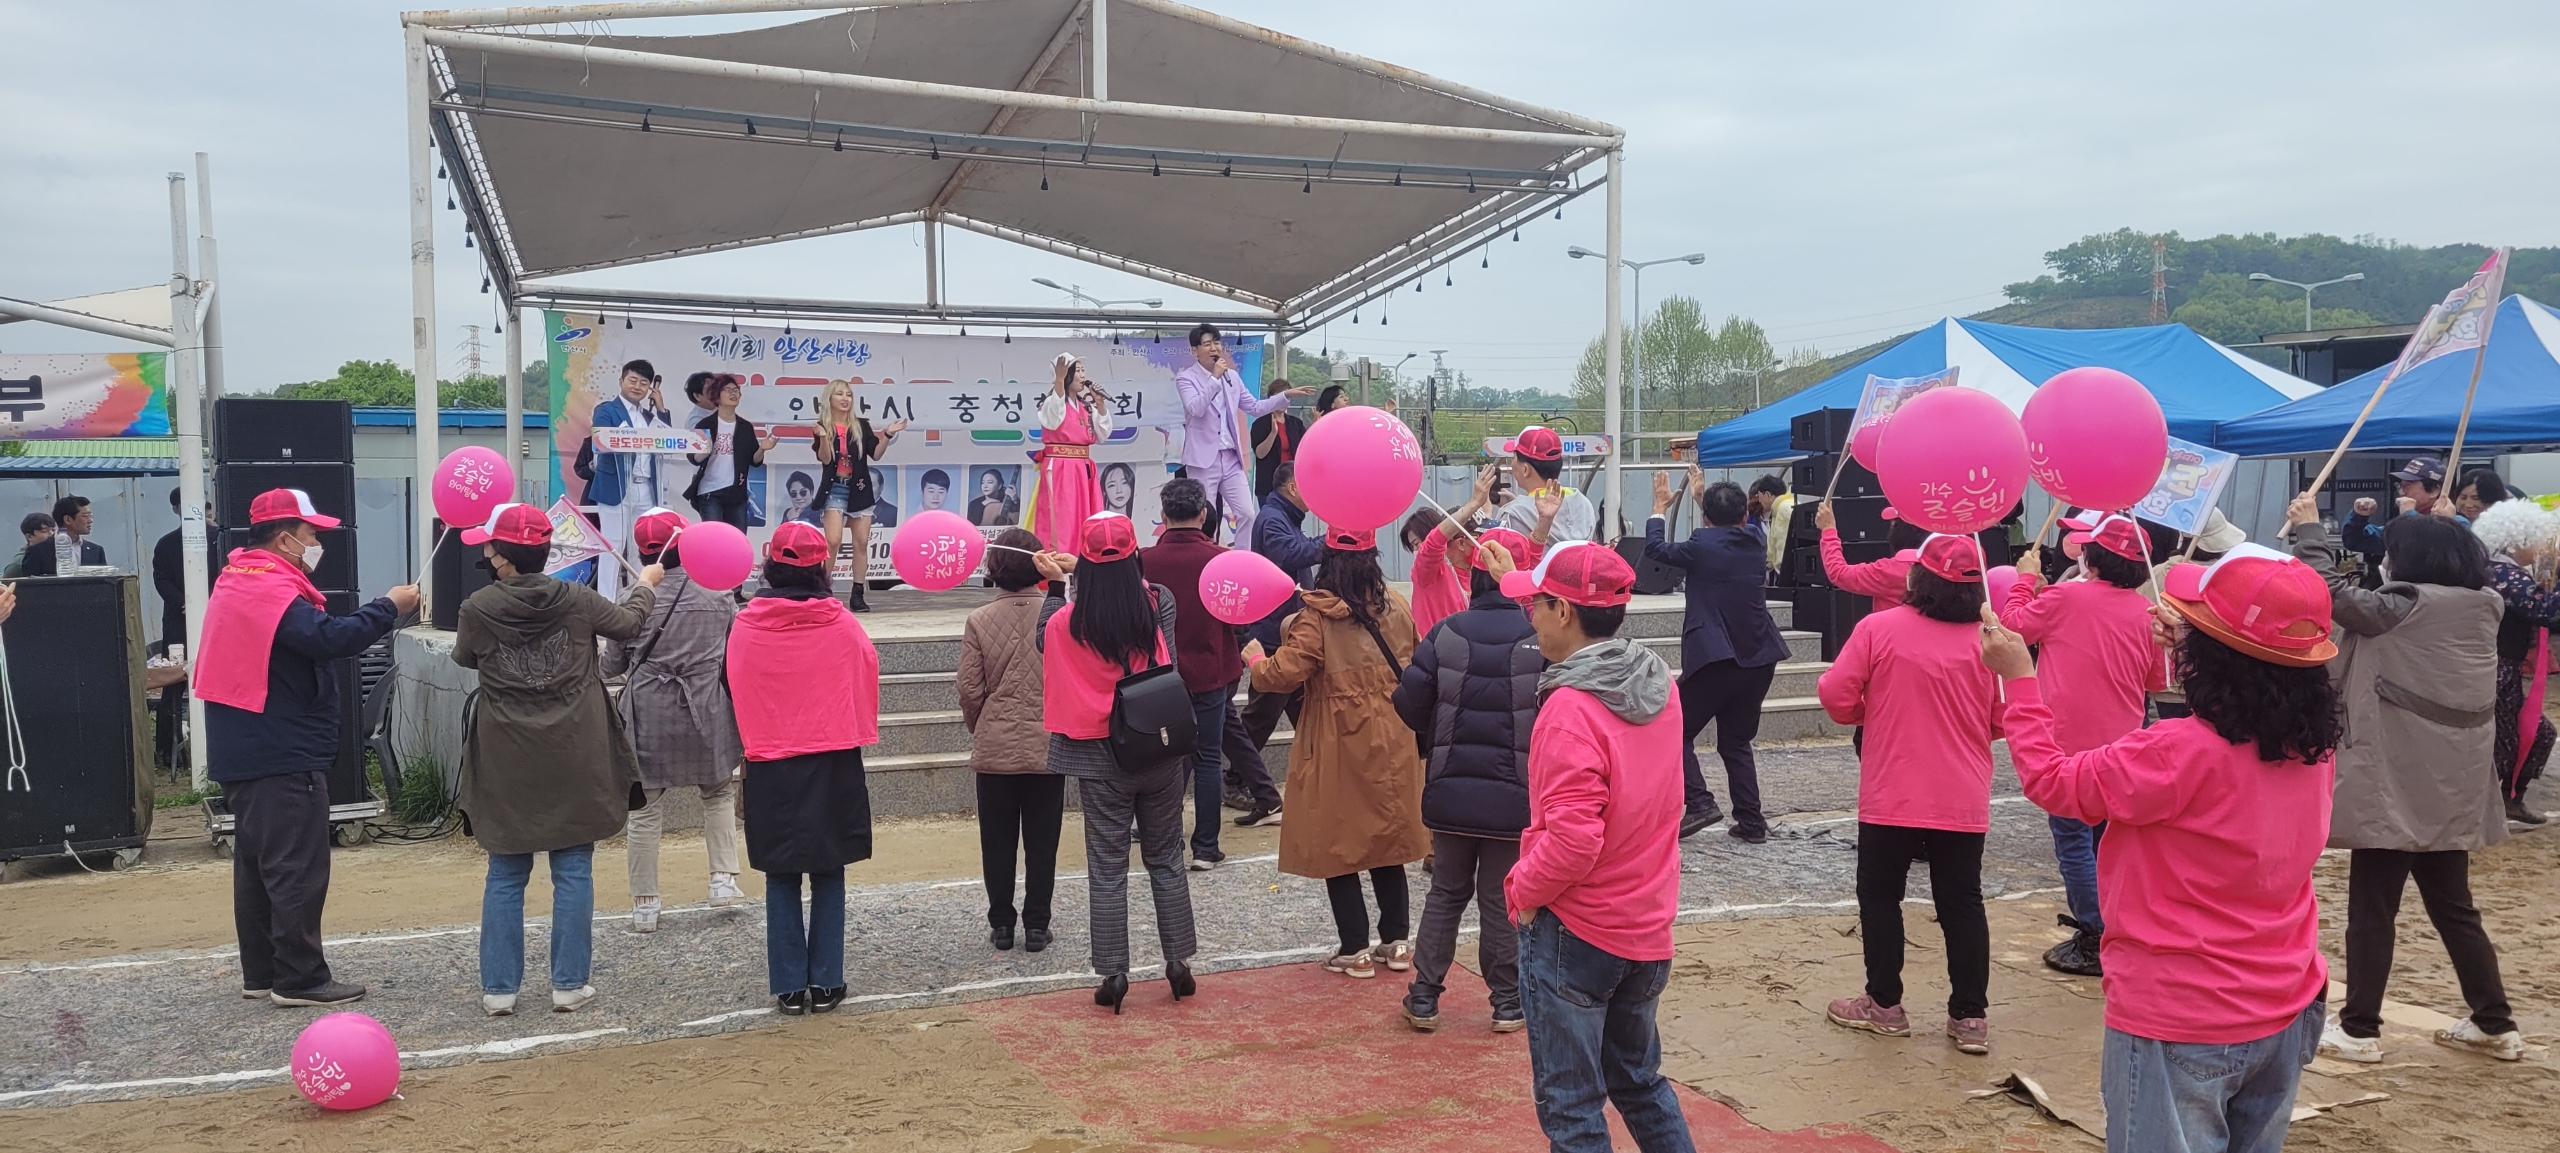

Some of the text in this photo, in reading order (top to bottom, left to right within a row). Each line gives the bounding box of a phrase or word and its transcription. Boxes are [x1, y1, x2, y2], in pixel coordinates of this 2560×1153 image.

[561, 345, 587, 354] 안산시
[701, 334, 873, 366] 제1회 안산사랑
[1110, 348, 1125, 357] 주최
[1132, 348, 1153, 357] 안산시
[949, 391, 1143, 424] 충청회
[609, 436, 688, 449] 팔도향우한마당
[1389, 436, 1402, 460] 가수
[460, 456, 475, 466] 가수
[1919, 482, 1953, 498] 가수
[925, 564, 935, 579] 가수
